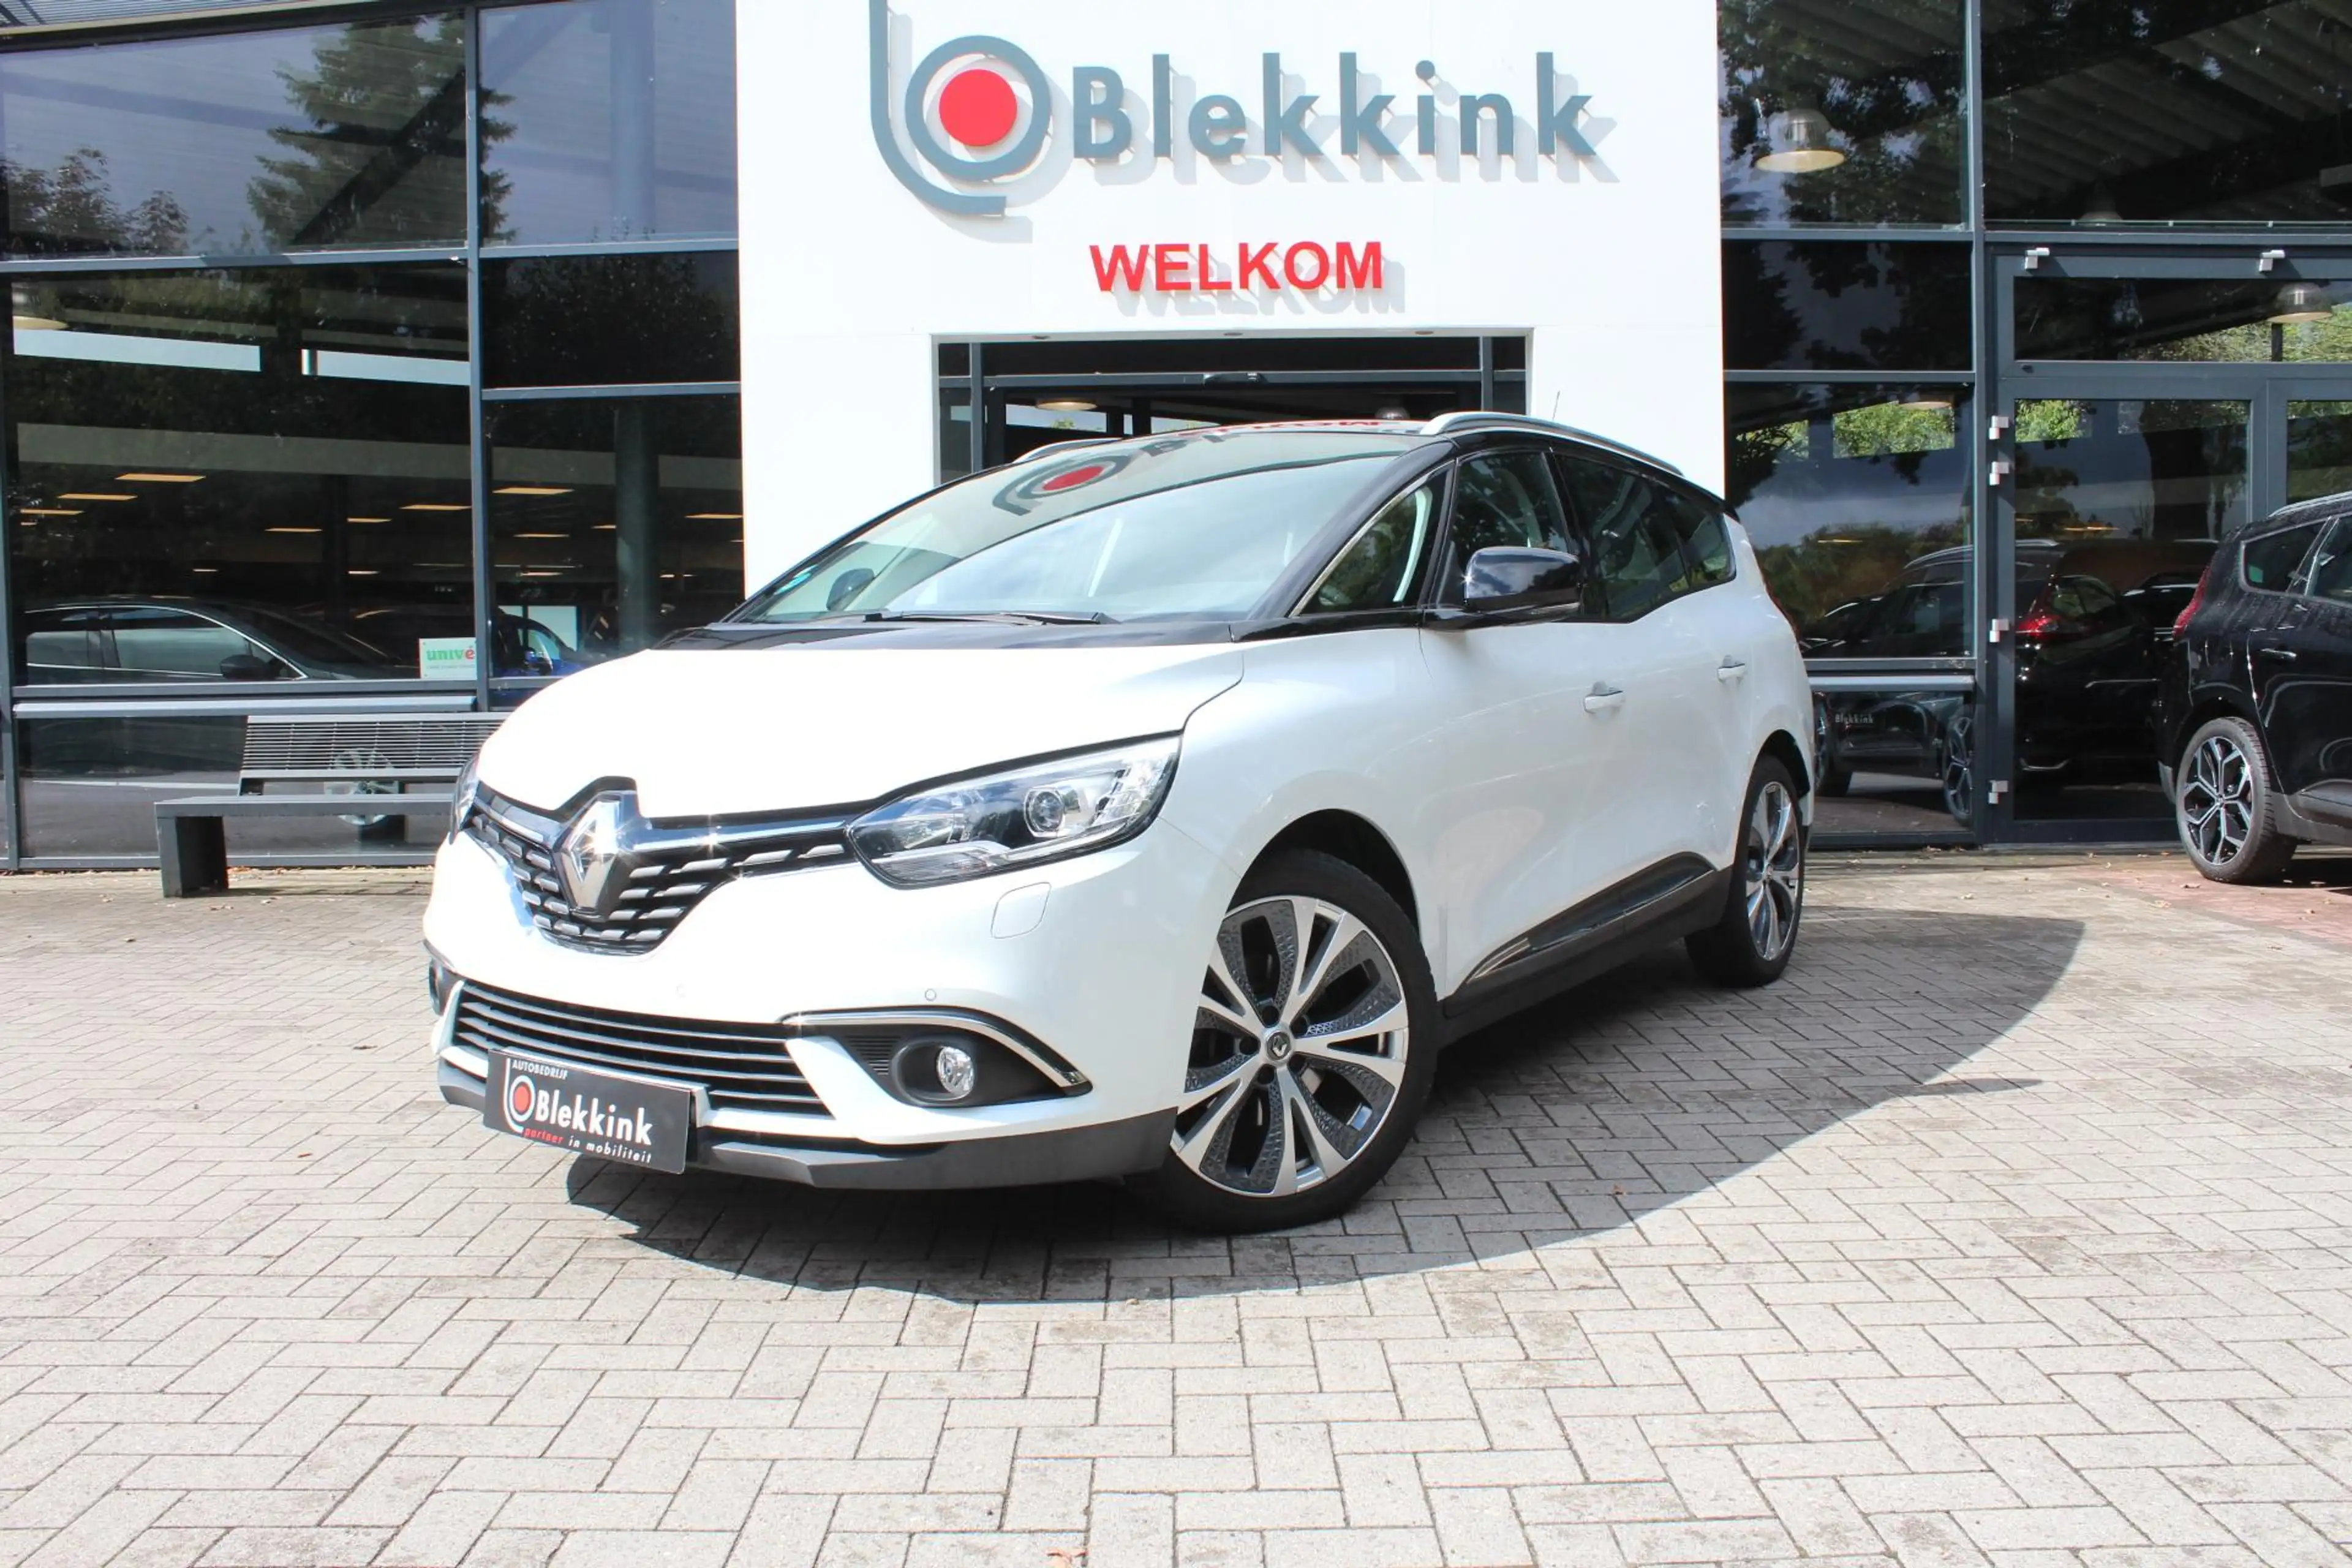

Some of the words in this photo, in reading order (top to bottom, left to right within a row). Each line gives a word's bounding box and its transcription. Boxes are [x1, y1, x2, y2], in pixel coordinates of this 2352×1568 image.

[1072, 52, 1596, 159] Blekkink
[1090, 241, 1383, 292] WELKOM
[512, 1060, 568, 1080] AUTOBEDRIJF
[535, 1089, 653, 1145] Blekkink
[524, 1128, 564, 1144] partner
[568, 1135, 580, 1148] in
[586, 1142, 652, 1164] mobiliteit
